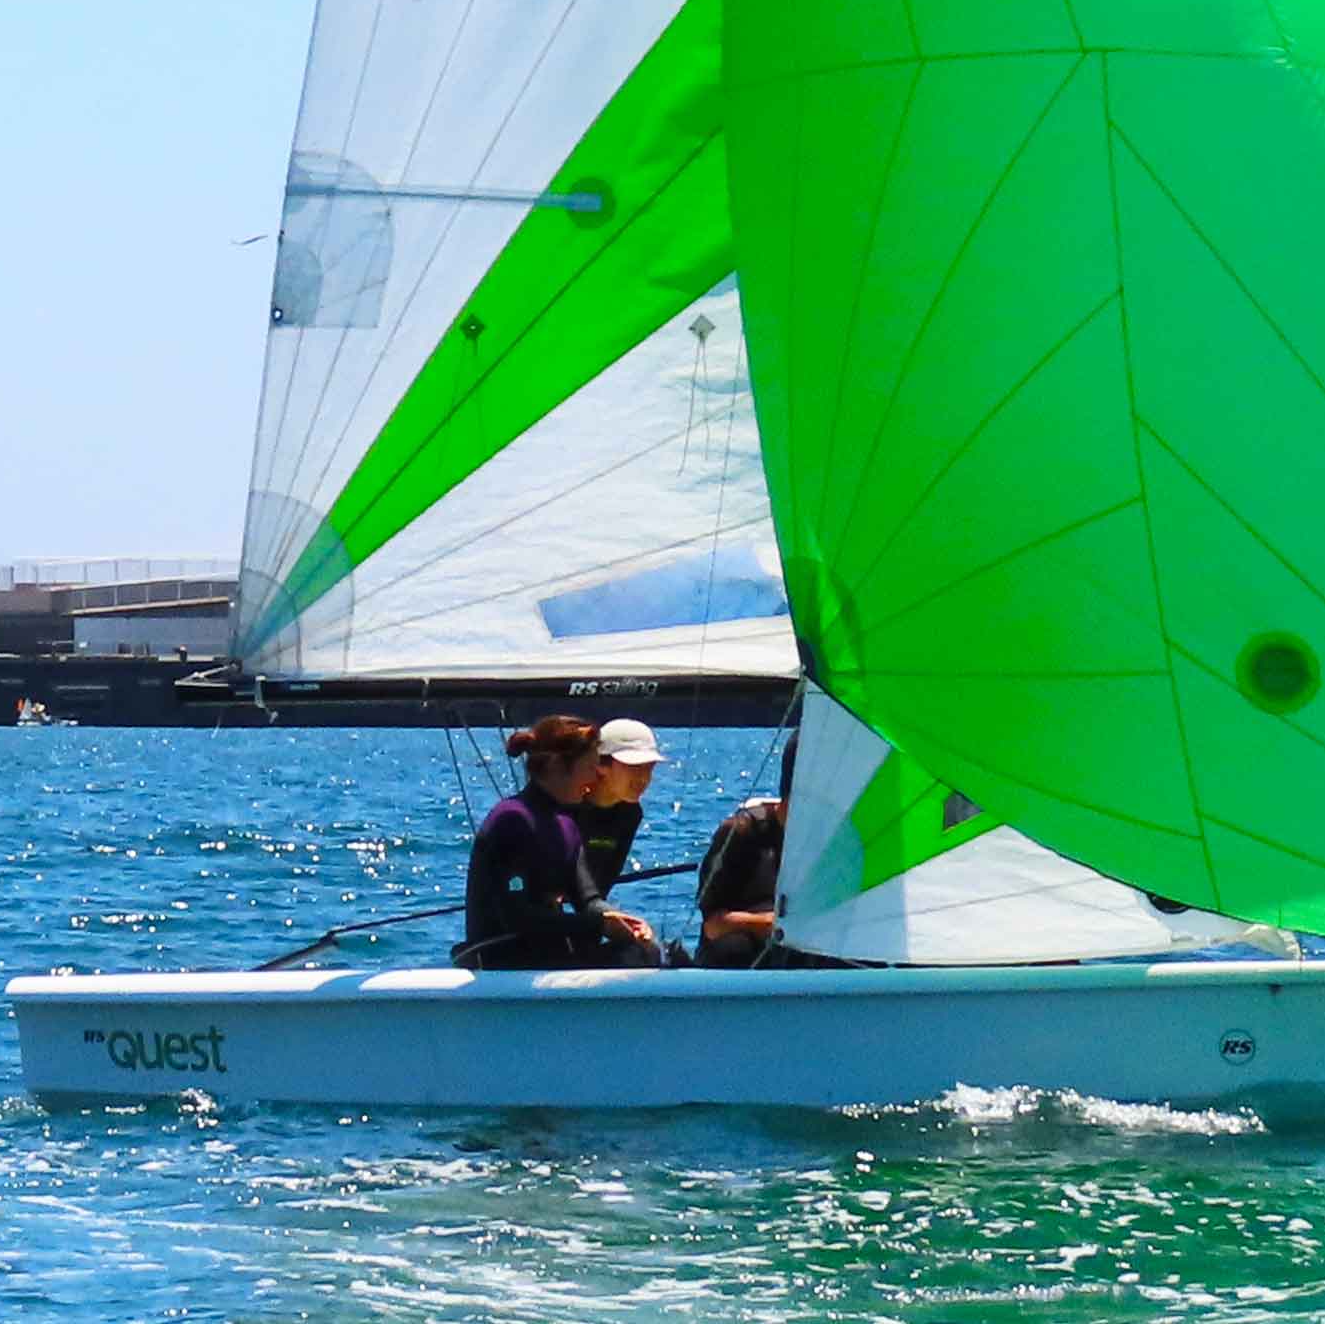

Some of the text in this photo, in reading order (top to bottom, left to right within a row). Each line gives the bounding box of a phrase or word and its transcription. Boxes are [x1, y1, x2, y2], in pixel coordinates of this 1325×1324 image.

[568, 681, 598, 696] RS
[108, 1025, 227, 1073] Quest
[1222, 1040, 1253, 1055] RS
